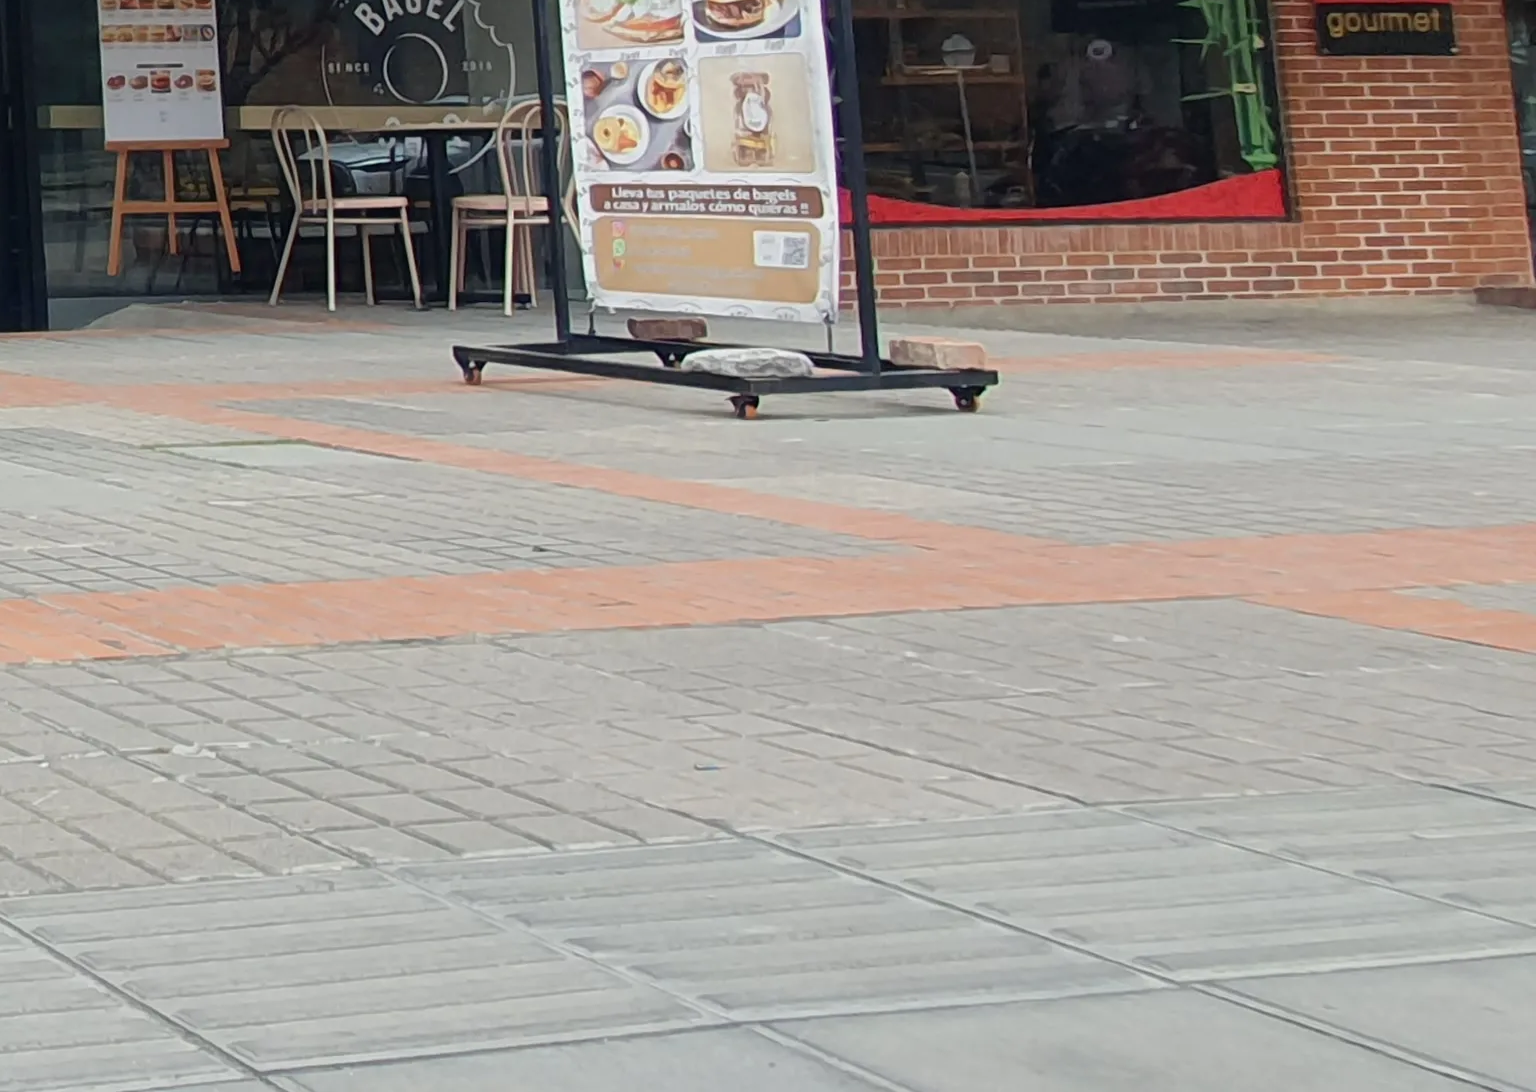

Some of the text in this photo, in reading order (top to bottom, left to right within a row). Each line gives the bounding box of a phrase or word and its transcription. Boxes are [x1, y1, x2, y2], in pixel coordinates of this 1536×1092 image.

[1328, 9, 1441, 38] gourmet
[612, 187, 643, 199] Lleva
[668, 188, 731, 203] paquetes
[733, 189, 750, 200] de
[753, 189, 797, 205] bagels
[642, 203, 650, 212] y
